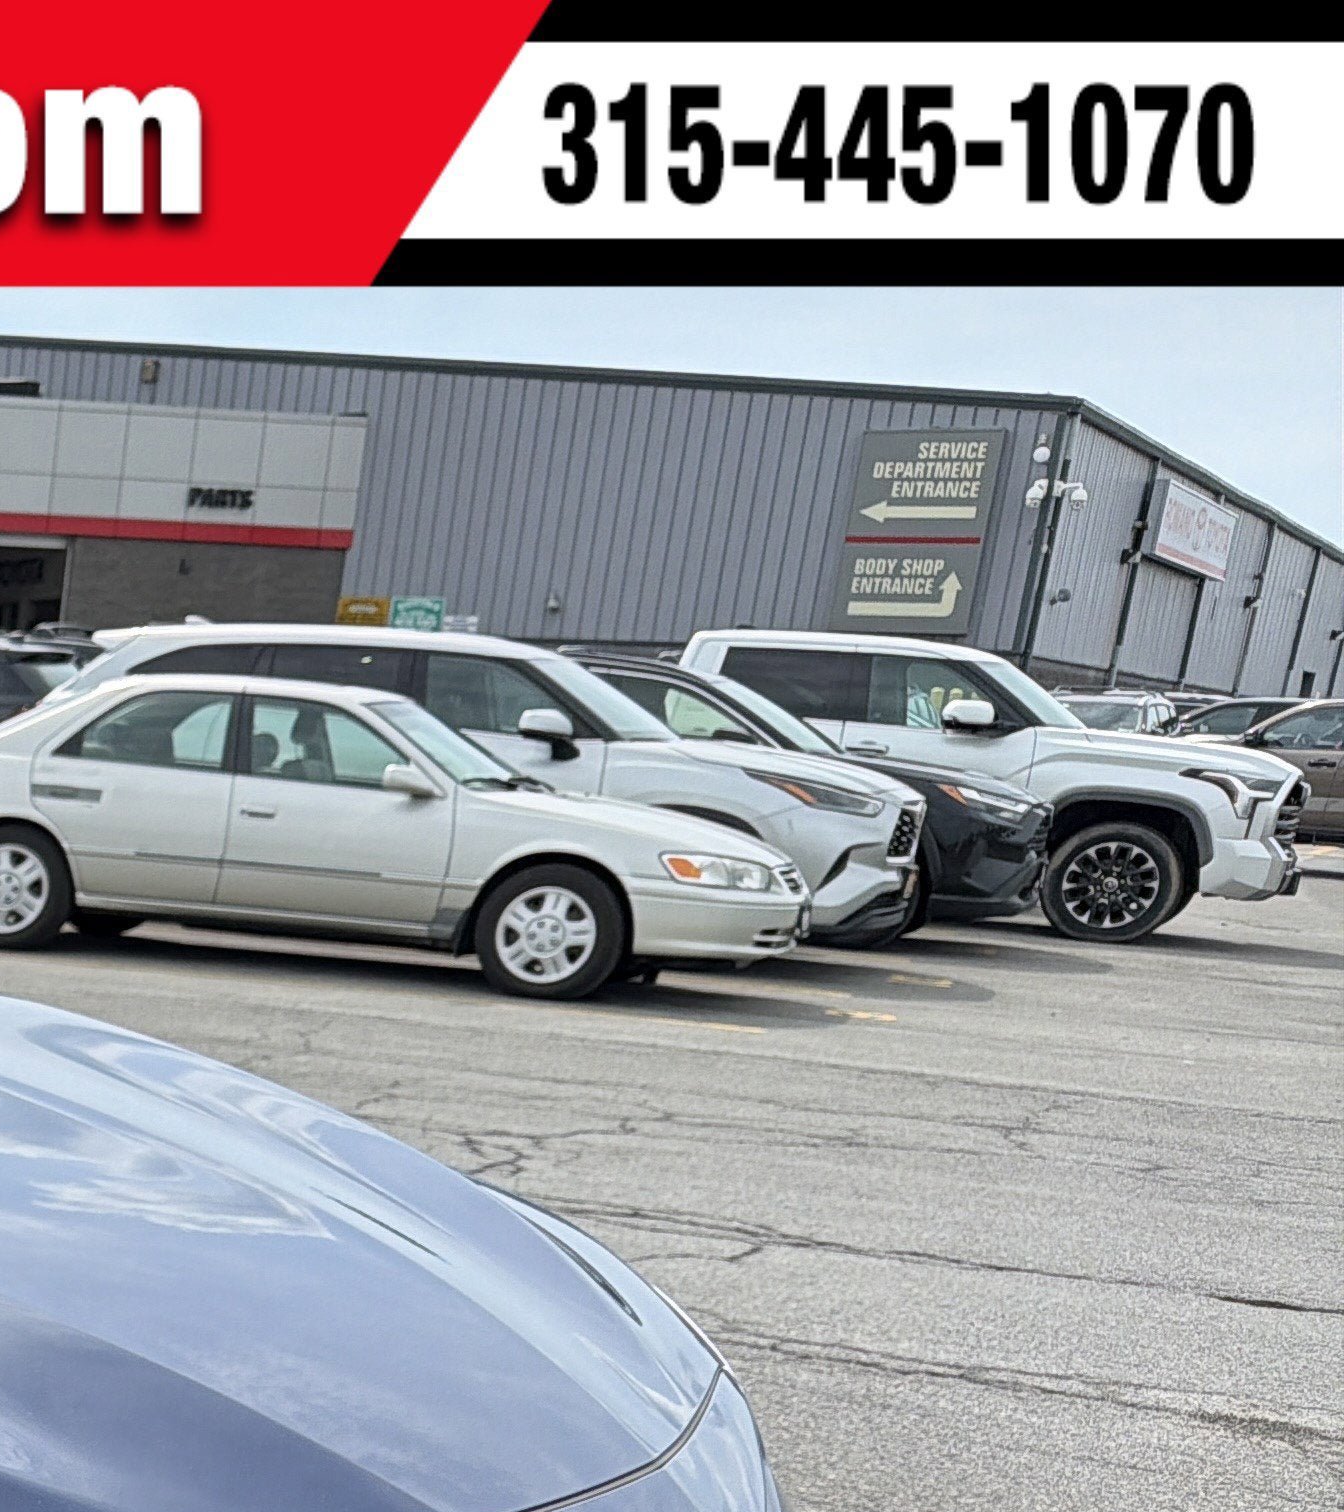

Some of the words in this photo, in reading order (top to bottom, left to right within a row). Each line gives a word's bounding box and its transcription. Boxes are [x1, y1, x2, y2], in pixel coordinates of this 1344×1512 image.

[917, 441, 989, 459] SERVICE
[872, 461, 986, 479] DEPARTMENT
[188, 486, 254, 510] PARTS
[890, 480, 981, 498] ENTRANCE
[853, 558, 898, 575] BODY
[901, 558, 945, 576] SHOP
[850, 577, 935, 594] ENTRANCE
